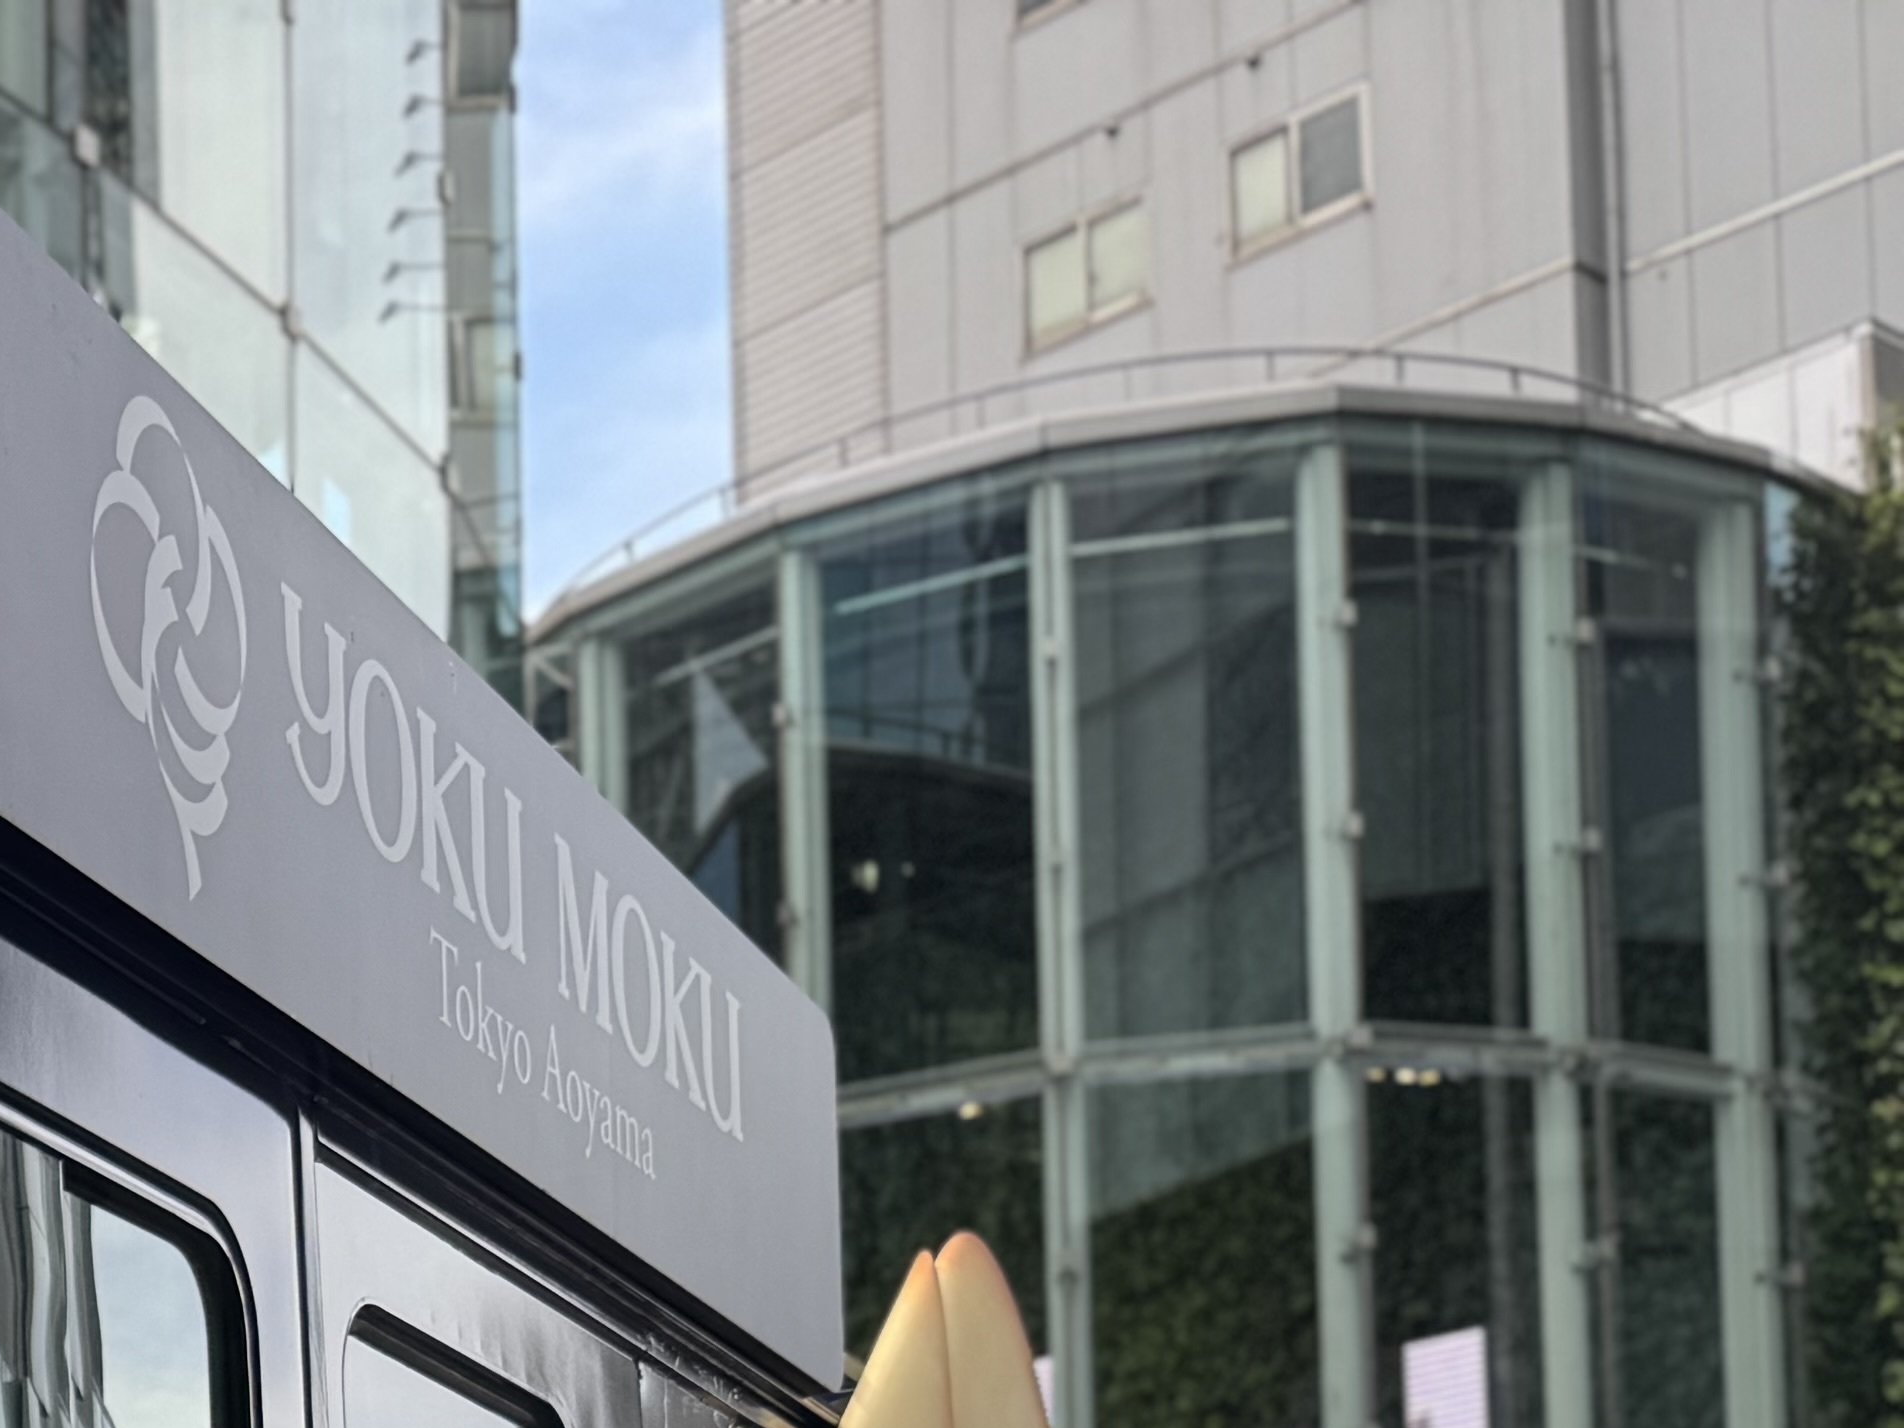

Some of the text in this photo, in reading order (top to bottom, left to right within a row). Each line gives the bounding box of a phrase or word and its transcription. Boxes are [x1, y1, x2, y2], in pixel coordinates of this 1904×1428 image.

[281, 582, 744, 1142] YOKU MOKU
[428, 926, 657, 1181] Tokyo Aoyama
